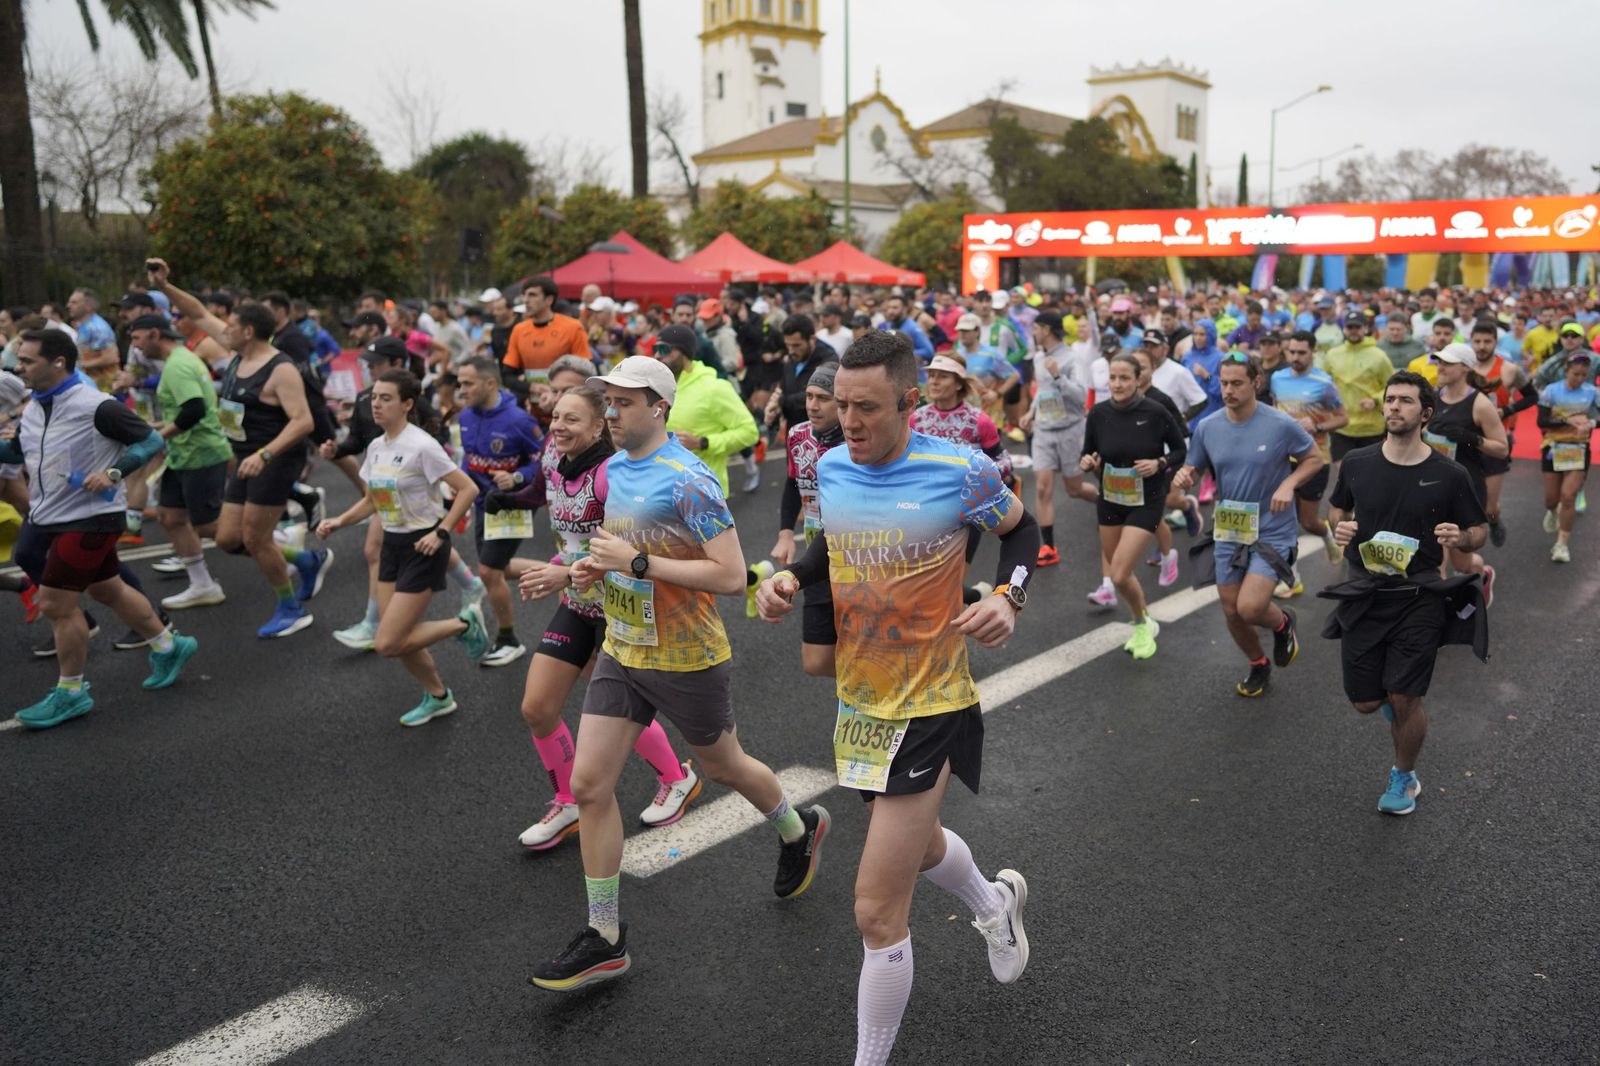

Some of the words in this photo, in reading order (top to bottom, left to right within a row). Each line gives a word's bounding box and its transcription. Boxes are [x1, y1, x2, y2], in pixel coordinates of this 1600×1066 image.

[896, 501, 920, 511] HOKA
[1220, 510, 1247, 526] 9127
[826, 527, 904, 552] MEDIO
[1368, 543, 1405, 562] 9896
[609, 584, 635, 616] 9741
[841, 718, 896, 752] 10358
